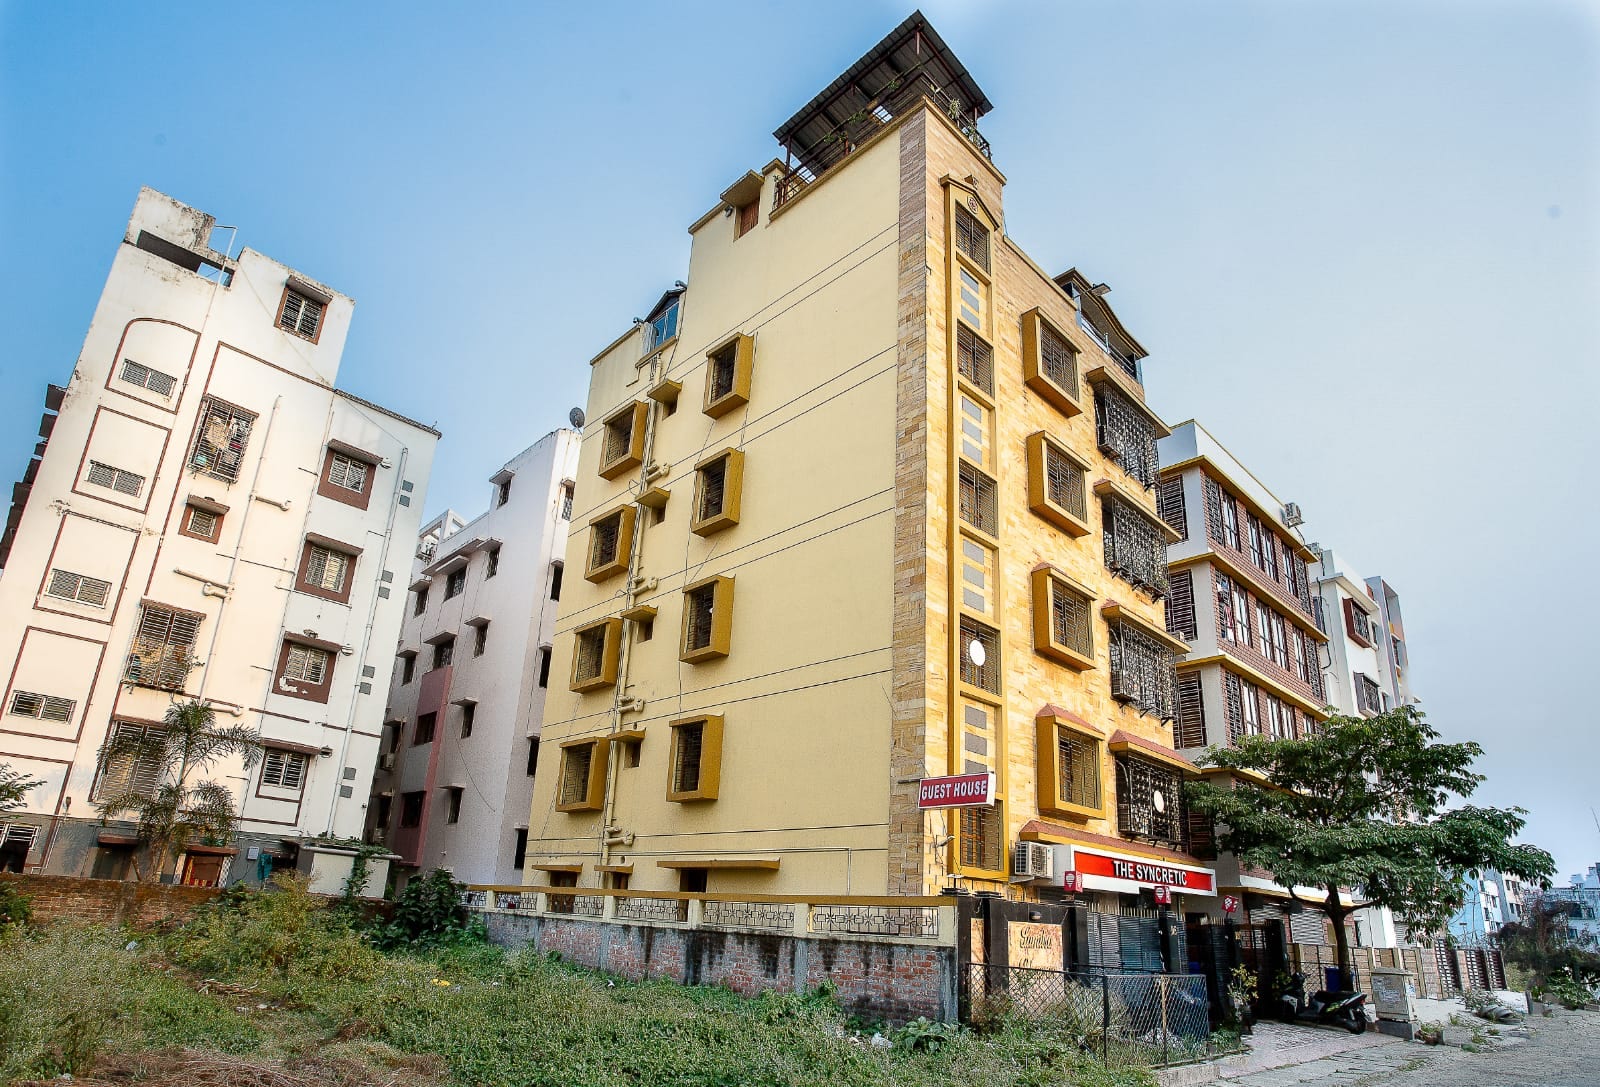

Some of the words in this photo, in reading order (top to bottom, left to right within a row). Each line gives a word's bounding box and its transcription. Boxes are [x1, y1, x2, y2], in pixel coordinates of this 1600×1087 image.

[921, 783, 952, 800] GUEST
[953, 780, 987, 798] HOUSE
[1113, 860, 1135, 879] THE
[1136, 864, 1188, 886] SYNCRETIC
